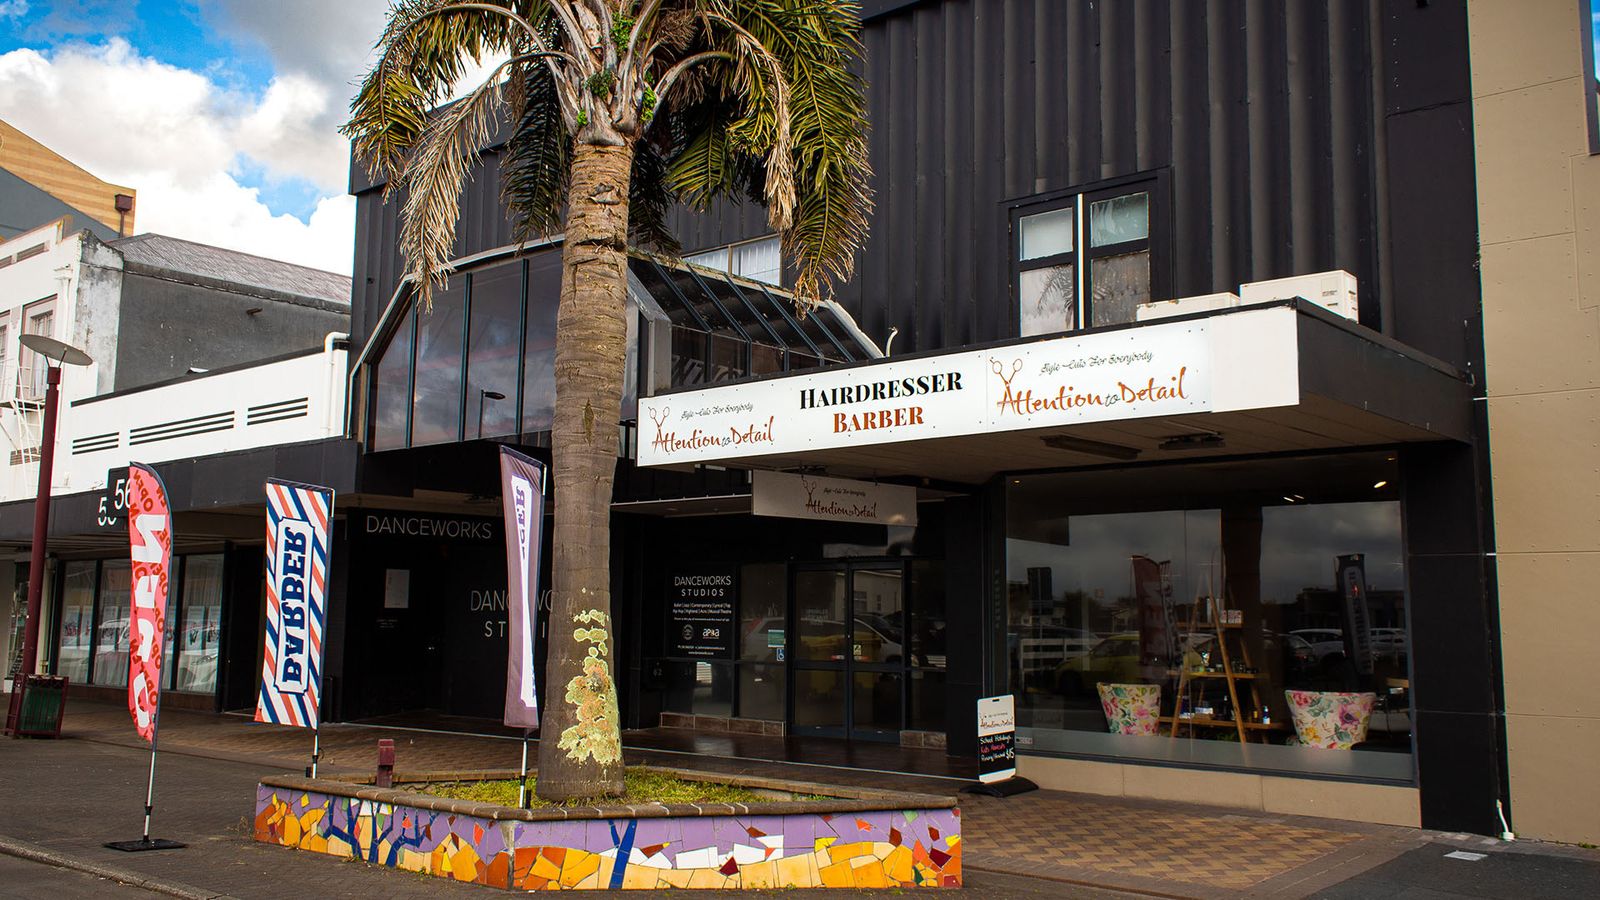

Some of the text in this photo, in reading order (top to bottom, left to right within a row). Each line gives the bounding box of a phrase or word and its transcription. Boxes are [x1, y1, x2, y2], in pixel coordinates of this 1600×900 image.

[1088, 355, 1107, 367] For
[799, 371, 963, 409] HAIRDRESSER
[996, 382, 1105, 416] Attention
[1117, 366, 1190, 404] Detail
[832, 406, 925, 434] BARBER
[652, 428, 721, 454] Attention
[730, 415, 775, 444] Detail
[366, 515, 493, 540] DANCEWORKS
[674, 575, 732, 587] DANCEWORKS
[681, 588, 725, 597] STUDIOS
